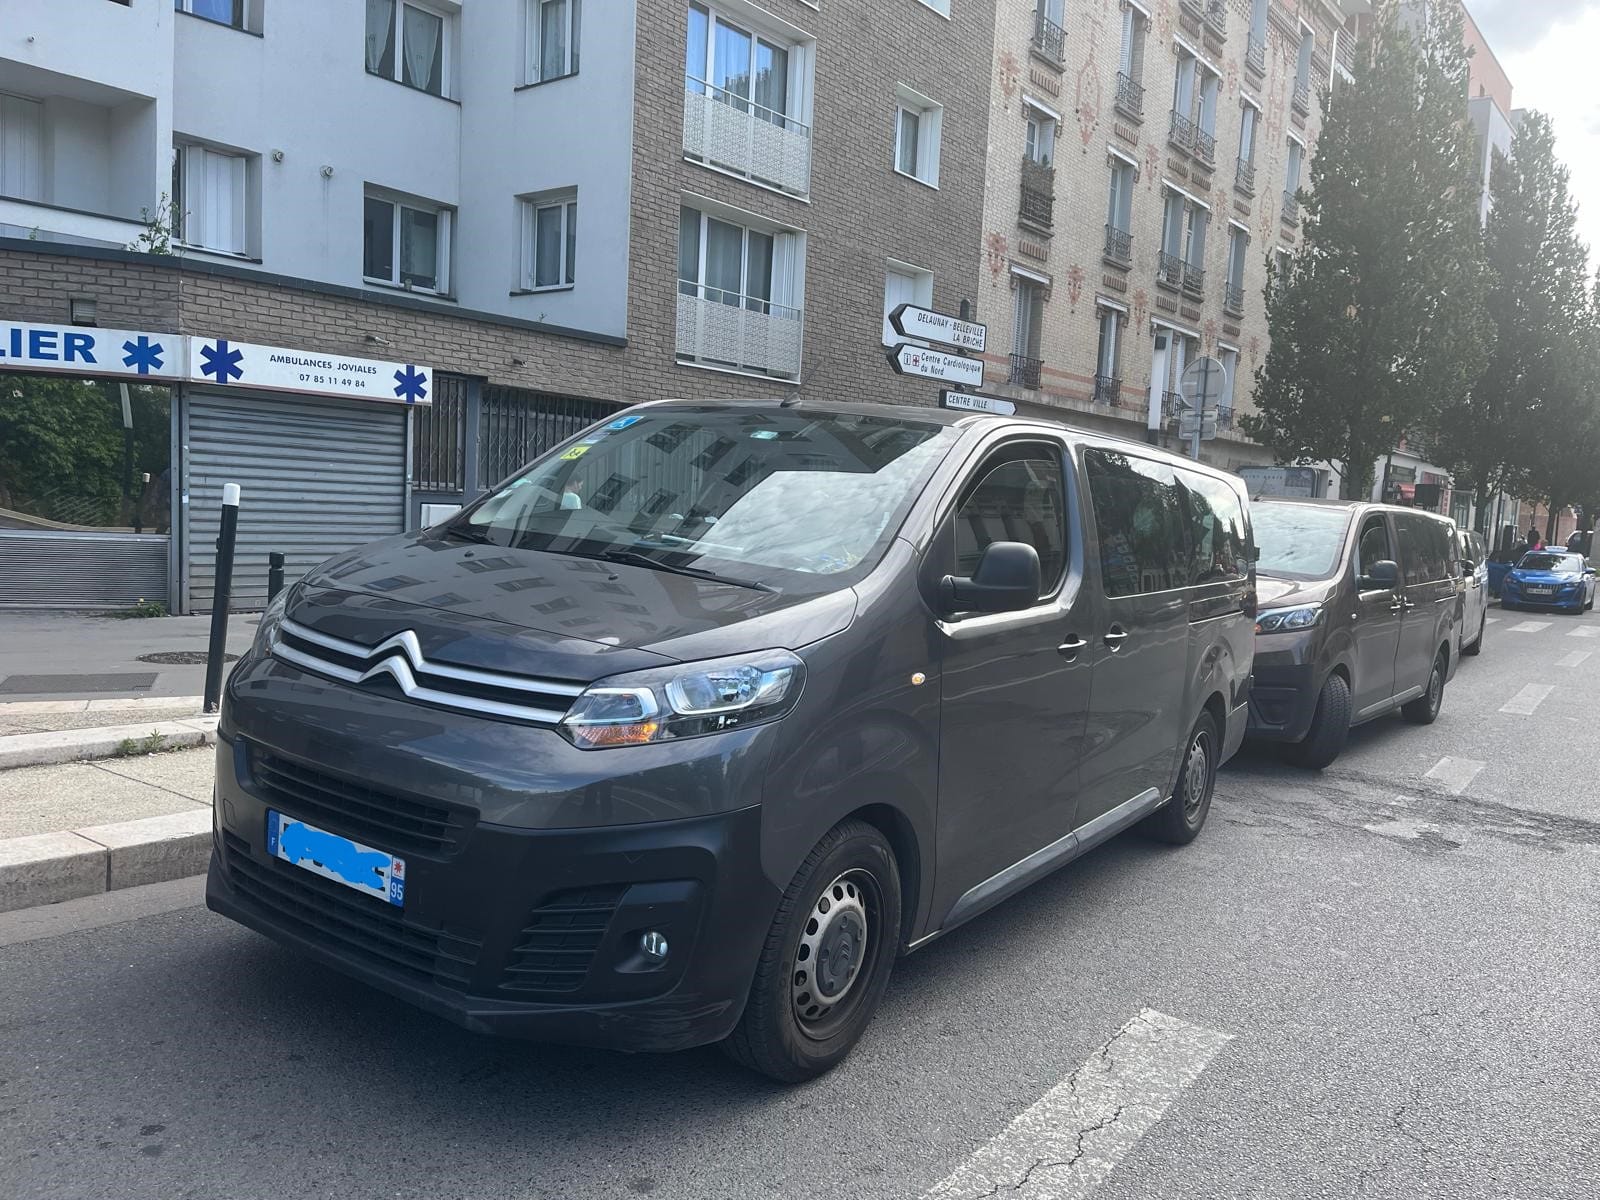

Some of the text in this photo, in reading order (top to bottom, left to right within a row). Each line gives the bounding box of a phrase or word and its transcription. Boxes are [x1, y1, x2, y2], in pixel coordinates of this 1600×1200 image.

[918, 312, 948, 329] DELAUNAY
[953, 321, 983, 337] BELLEVILLE
[0, 328, 97, 363] IER
[953, 334, 982, 348] LA BRICHE
[269, 354, 377, 374] AMBULANCES JOVIALES
[921, 352, 981, 374] Centre Cardiologique
[930, 366, 944, 376] Nord
[299, 374, 365, 388] 07 85 11 49 84
[948, 394, 988, 409] CENTRE VILLE
[271, 837, 276, 846] F
[390, 882, 404, 900] 95
